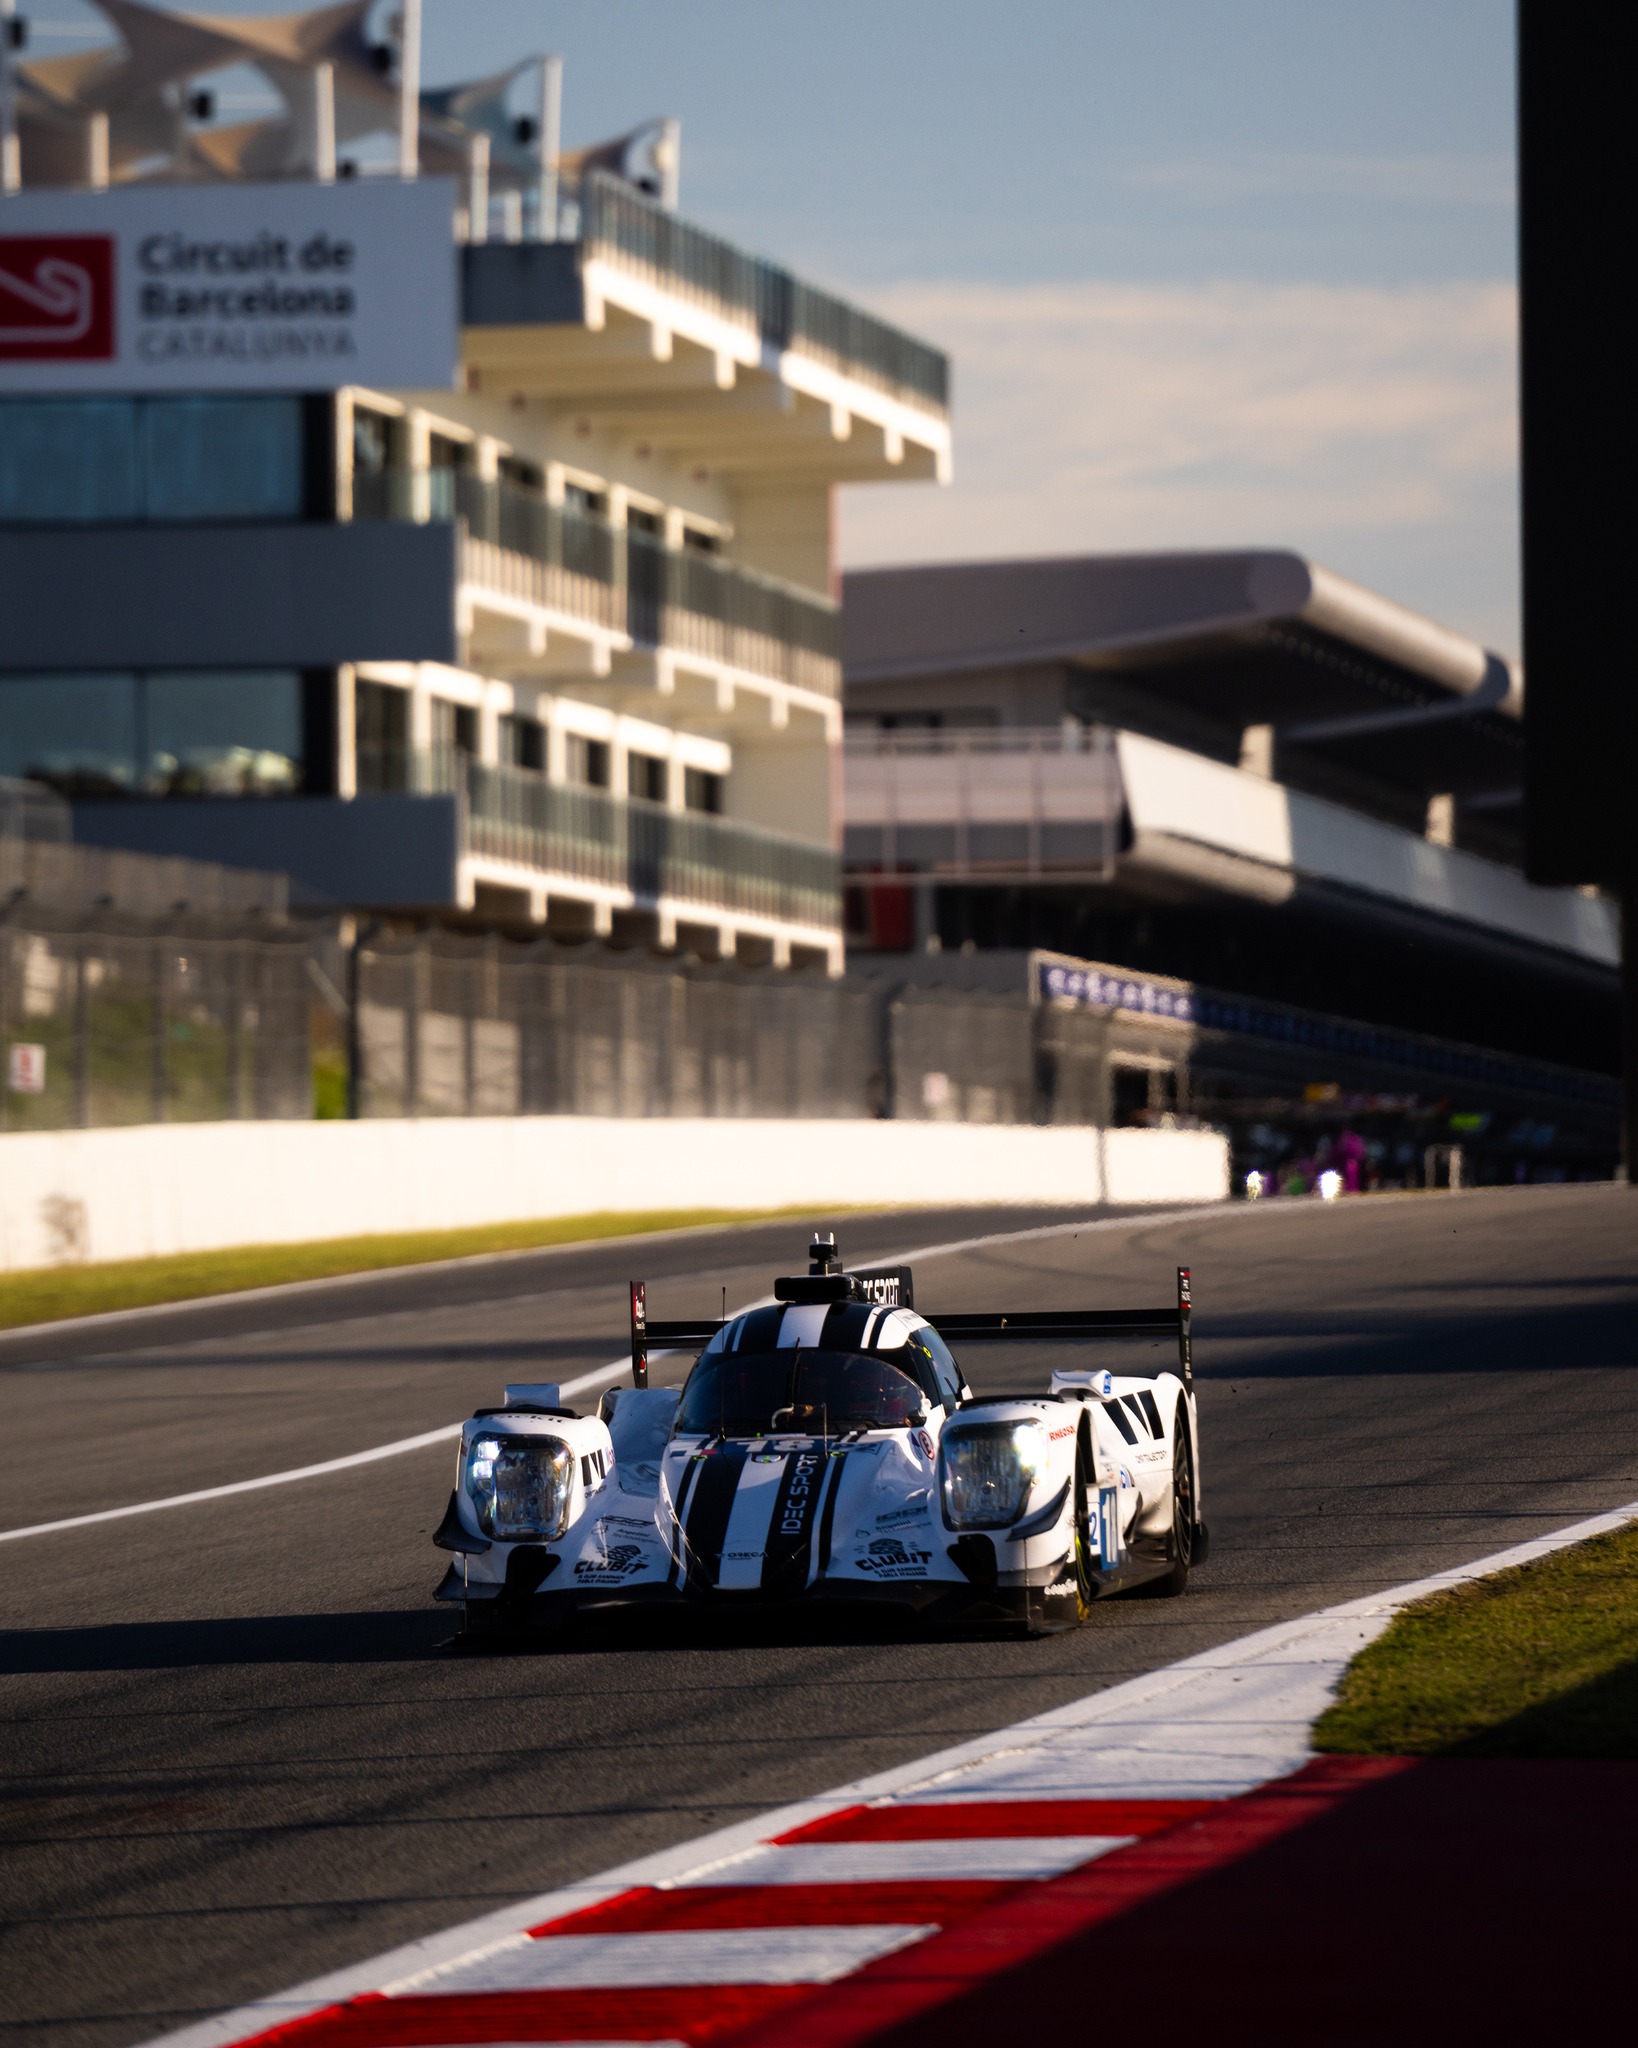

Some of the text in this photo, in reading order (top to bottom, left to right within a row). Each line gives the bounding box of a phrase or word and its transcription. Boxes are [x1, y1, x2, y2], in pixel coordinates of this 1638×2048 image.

[138, 231, 356, 273] Circuit de
[138, 281, 356, 319] Barcelona
[137, 326, 357, 360] CATALUNYA
[780, 1454, 819, 1535] IDEC SPORT
